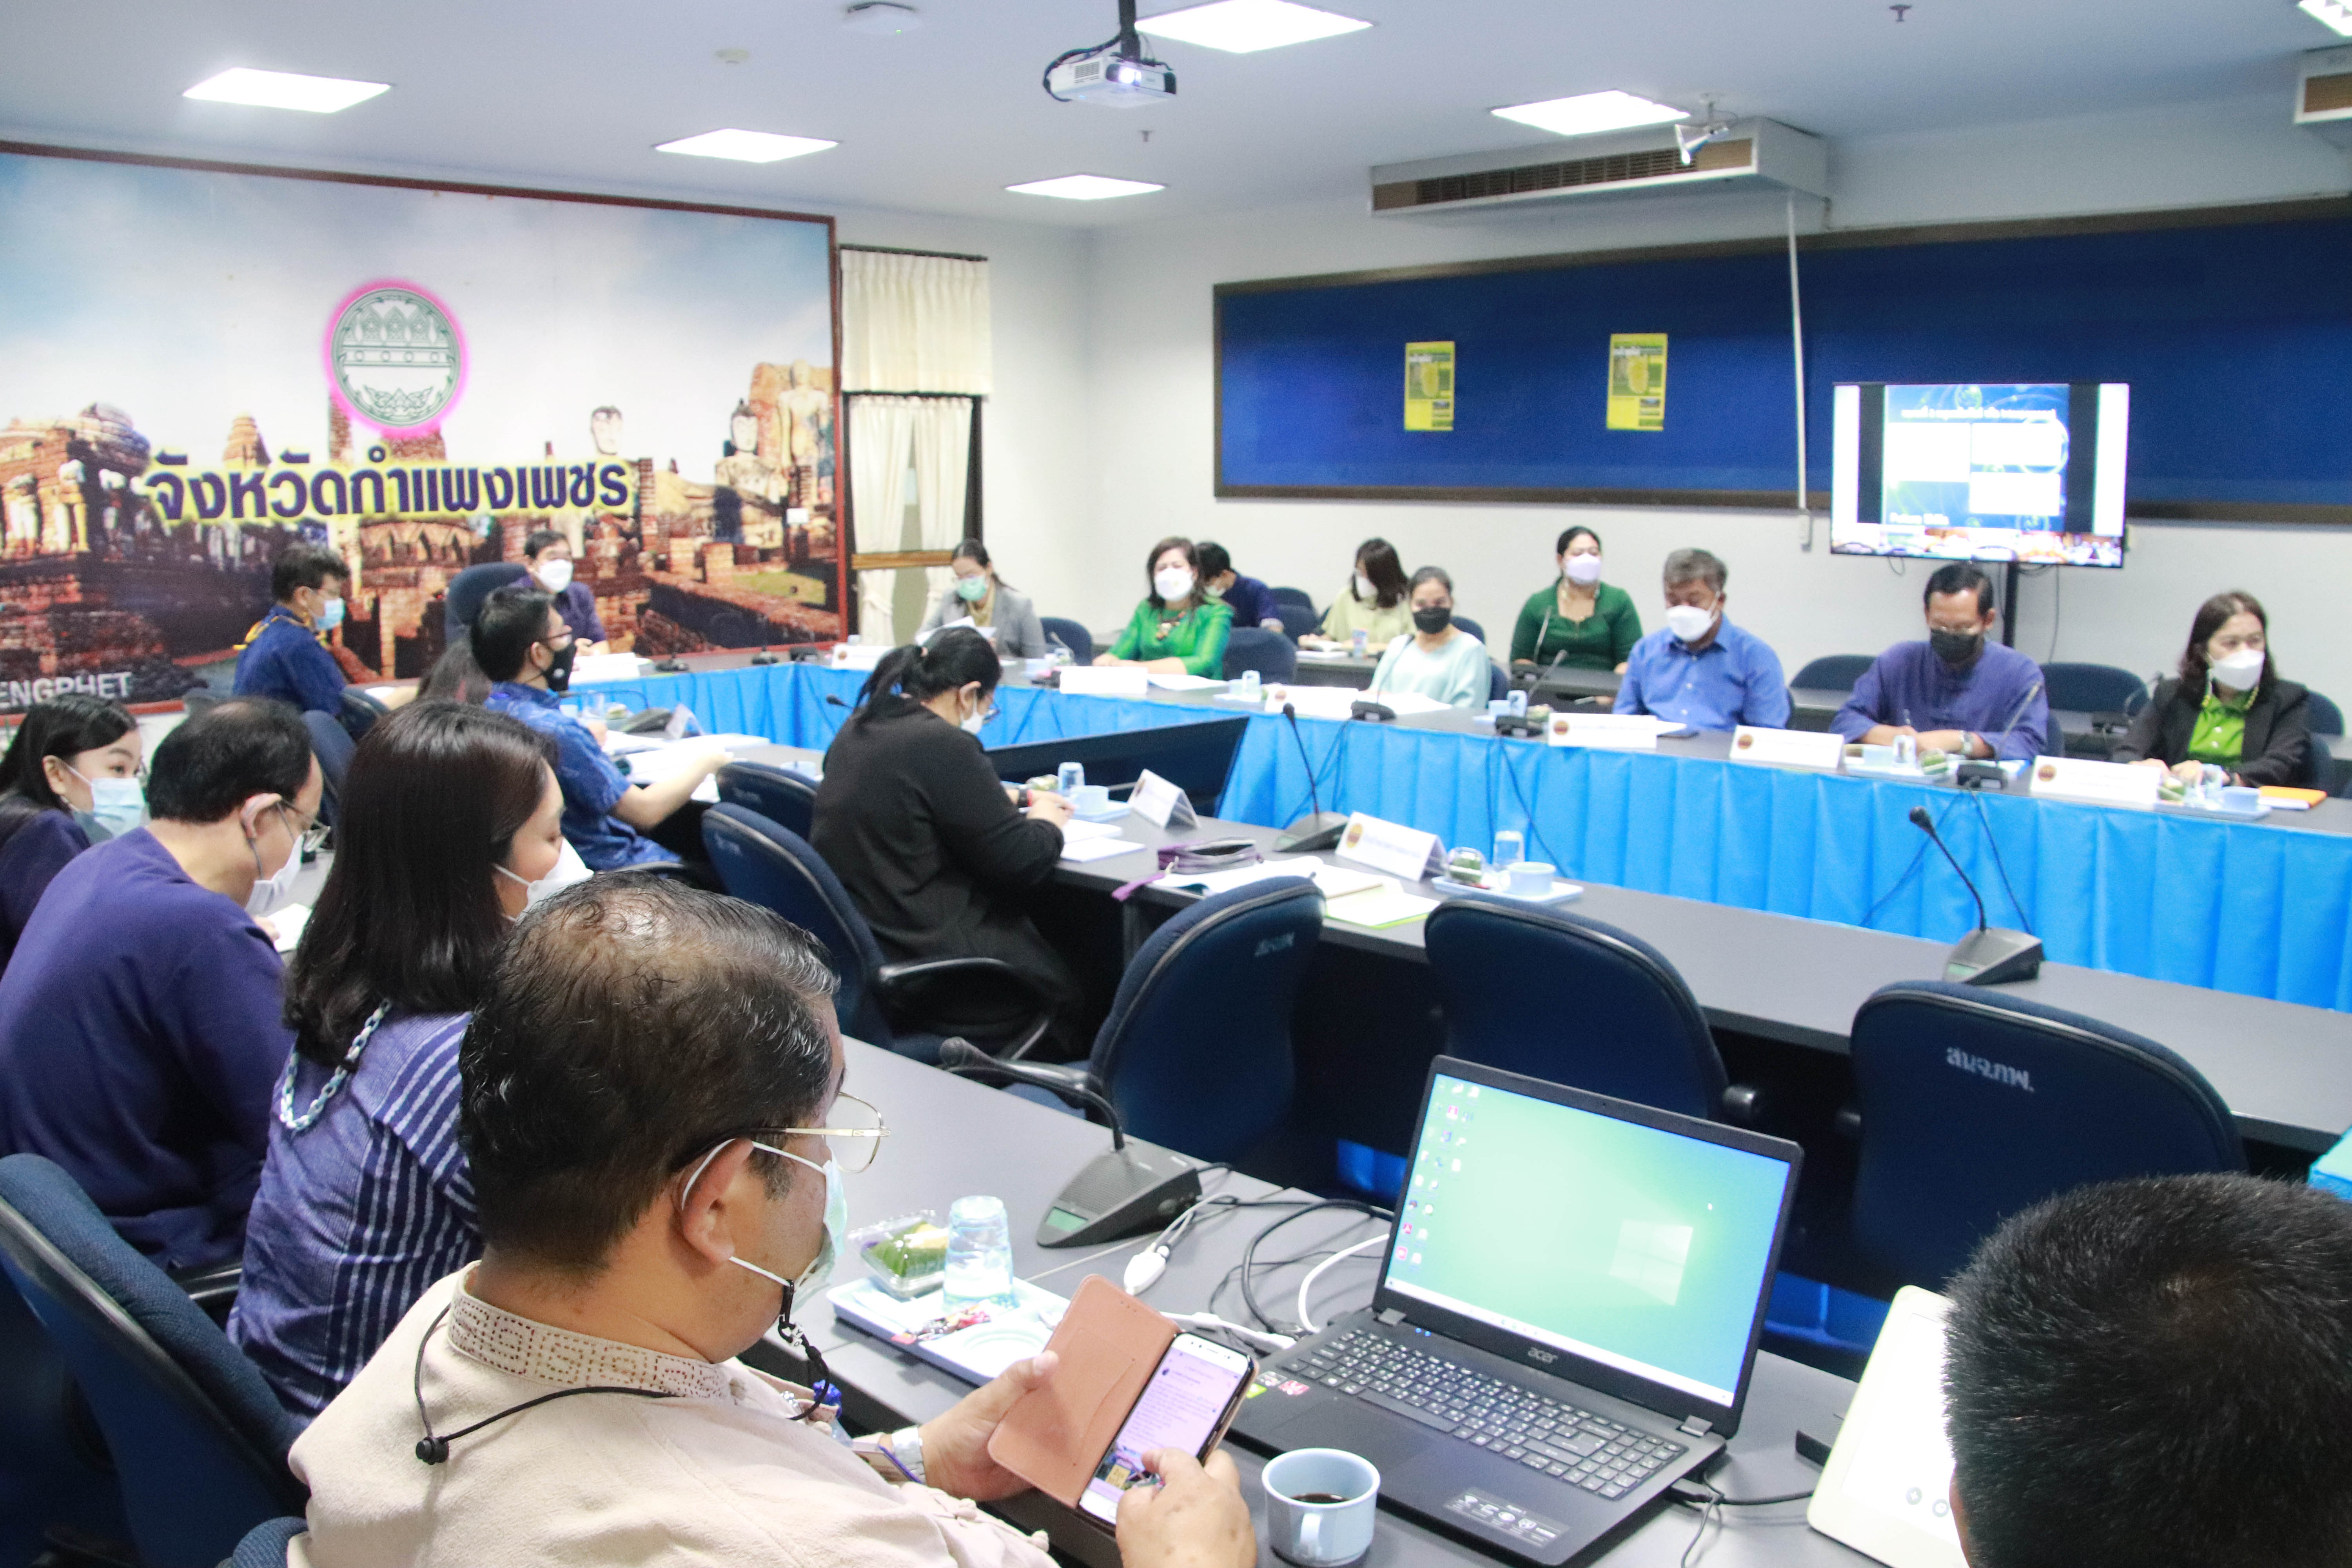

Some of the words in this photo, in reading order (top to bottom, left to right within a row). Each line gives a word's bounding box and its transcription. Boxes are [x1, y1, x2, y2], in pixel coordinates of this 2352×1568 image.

[145, 446, 628, 520] จังหวัดกำแพงเพชร
[1528, 1347, 1558, 1364] acer
